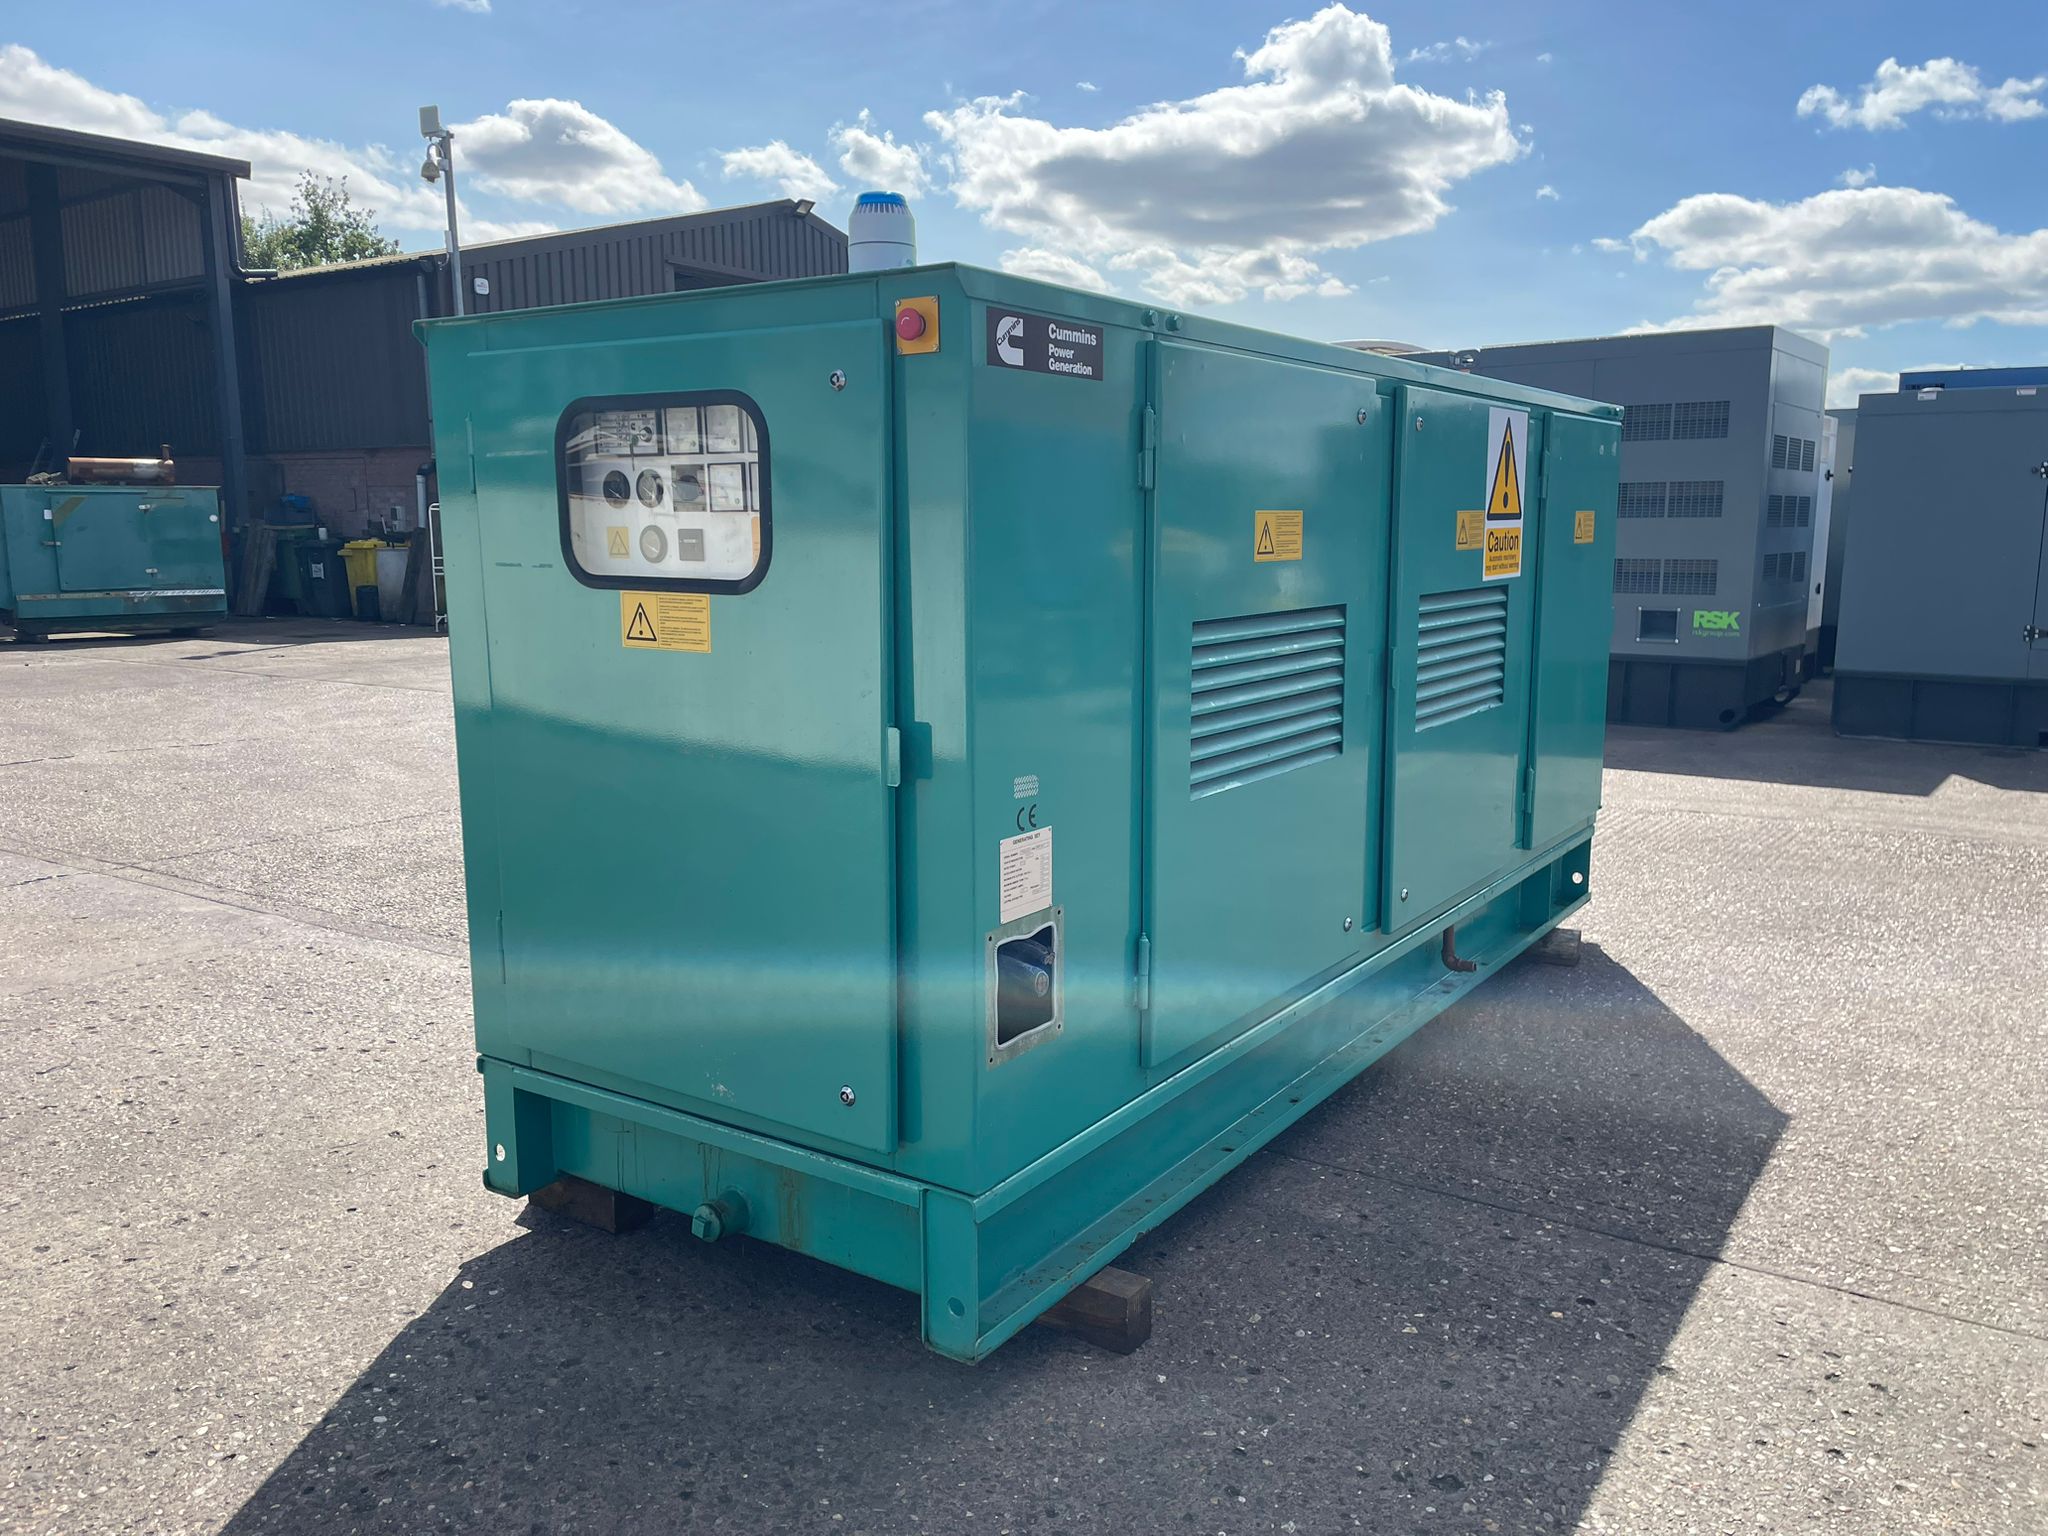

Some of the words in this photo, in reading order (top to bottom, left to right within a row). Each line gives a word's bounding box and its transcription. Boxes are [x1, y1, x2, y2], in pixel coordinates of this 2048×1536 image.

[1048, 322, 1097, 346] Cummins
[1048, 343, 1075, 359] Power
[1048, 359, 1093, 376] Generation
[1488, 531, 1519, 553] Caution
[1693, 610, 1740, 630] RSK
[1016, 803, 1037, 832] CE
